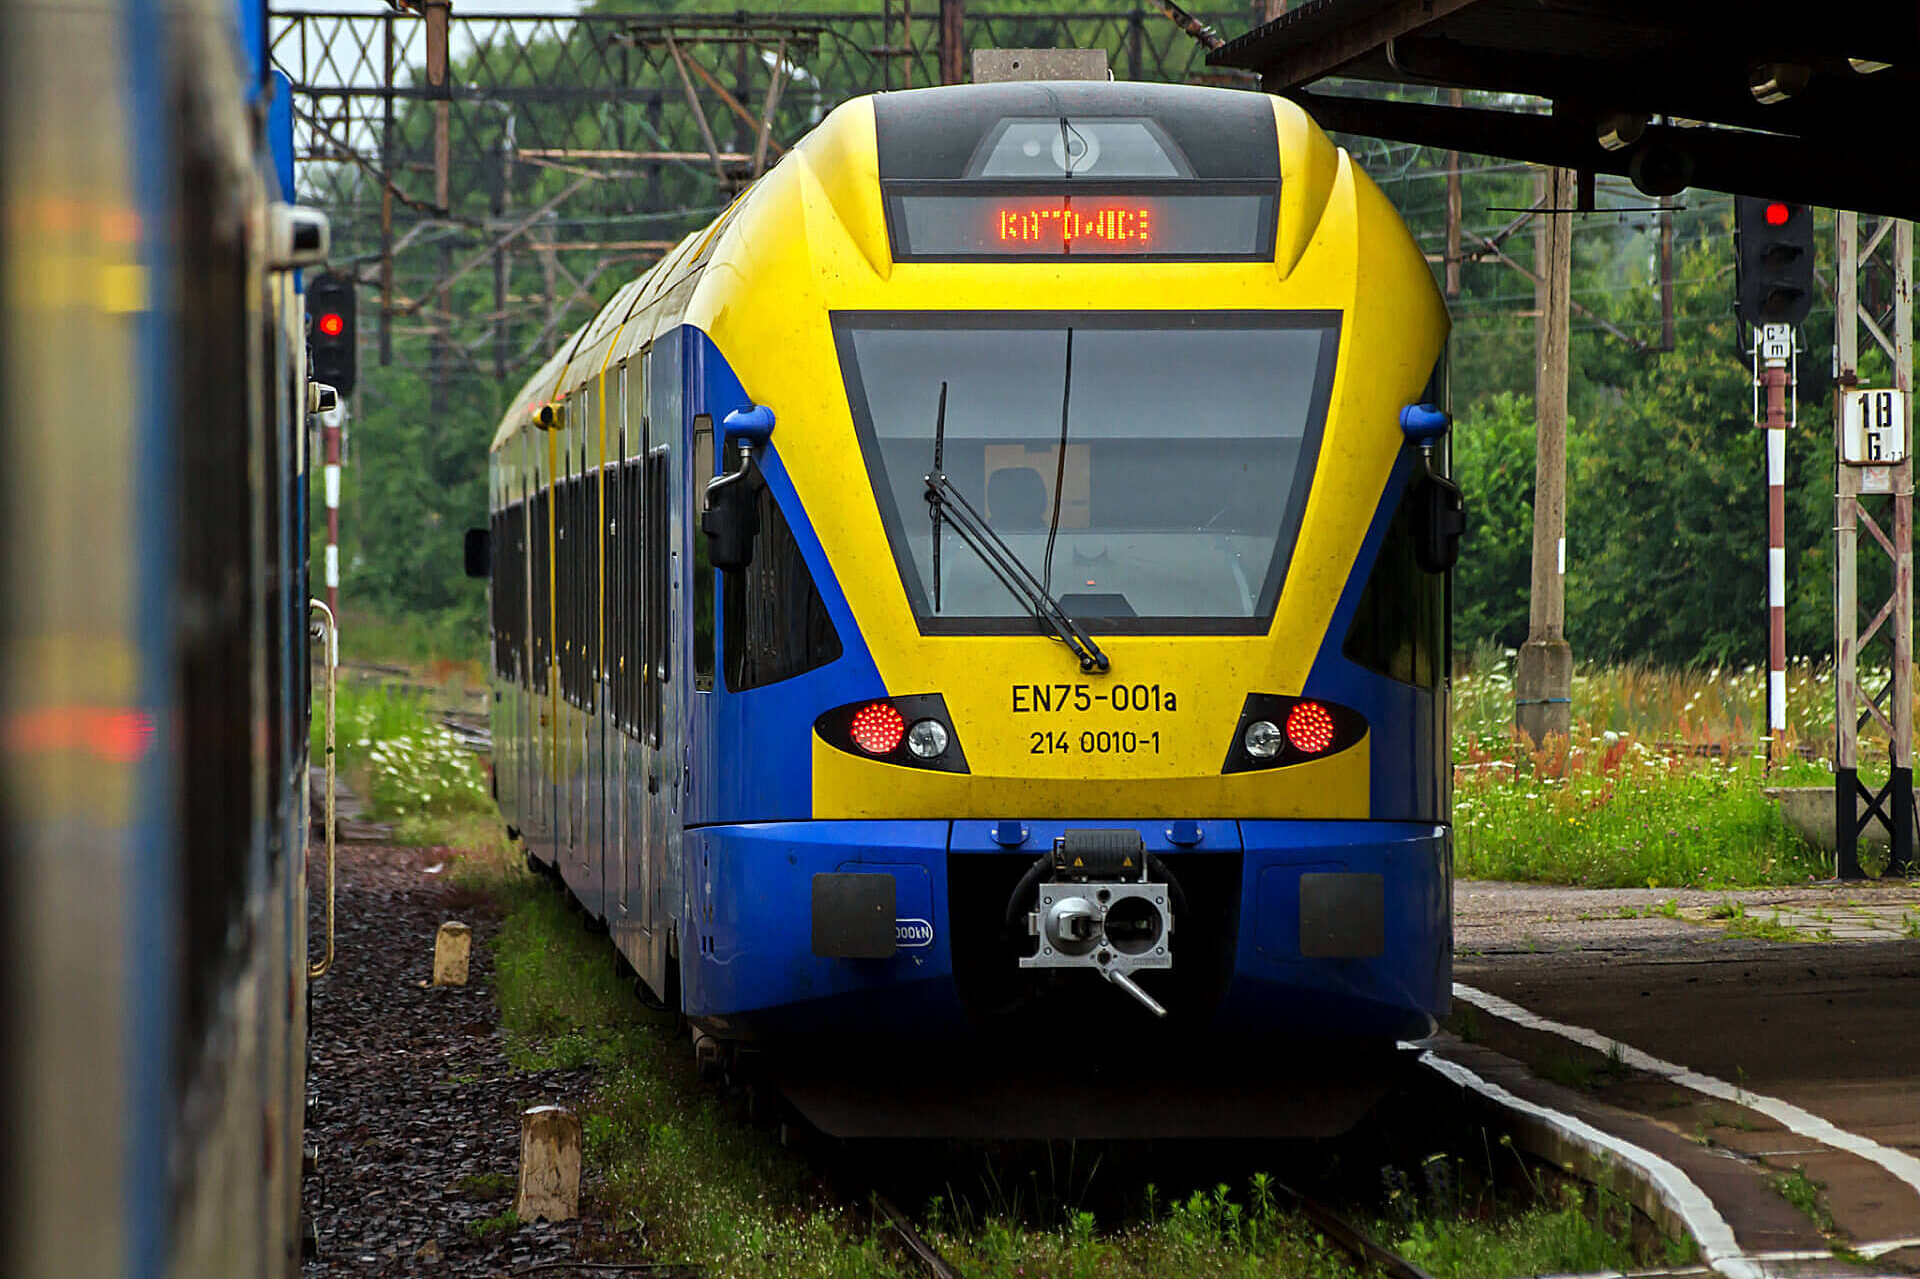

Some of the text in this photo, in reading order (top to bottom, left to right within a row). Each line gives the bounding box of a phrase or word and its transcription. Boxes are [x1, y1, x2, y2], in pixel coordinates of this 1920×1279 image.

[1012, 684, 1177, 712] EN75-001a
[1029, 731, 1160, 754] 214 0010-1
